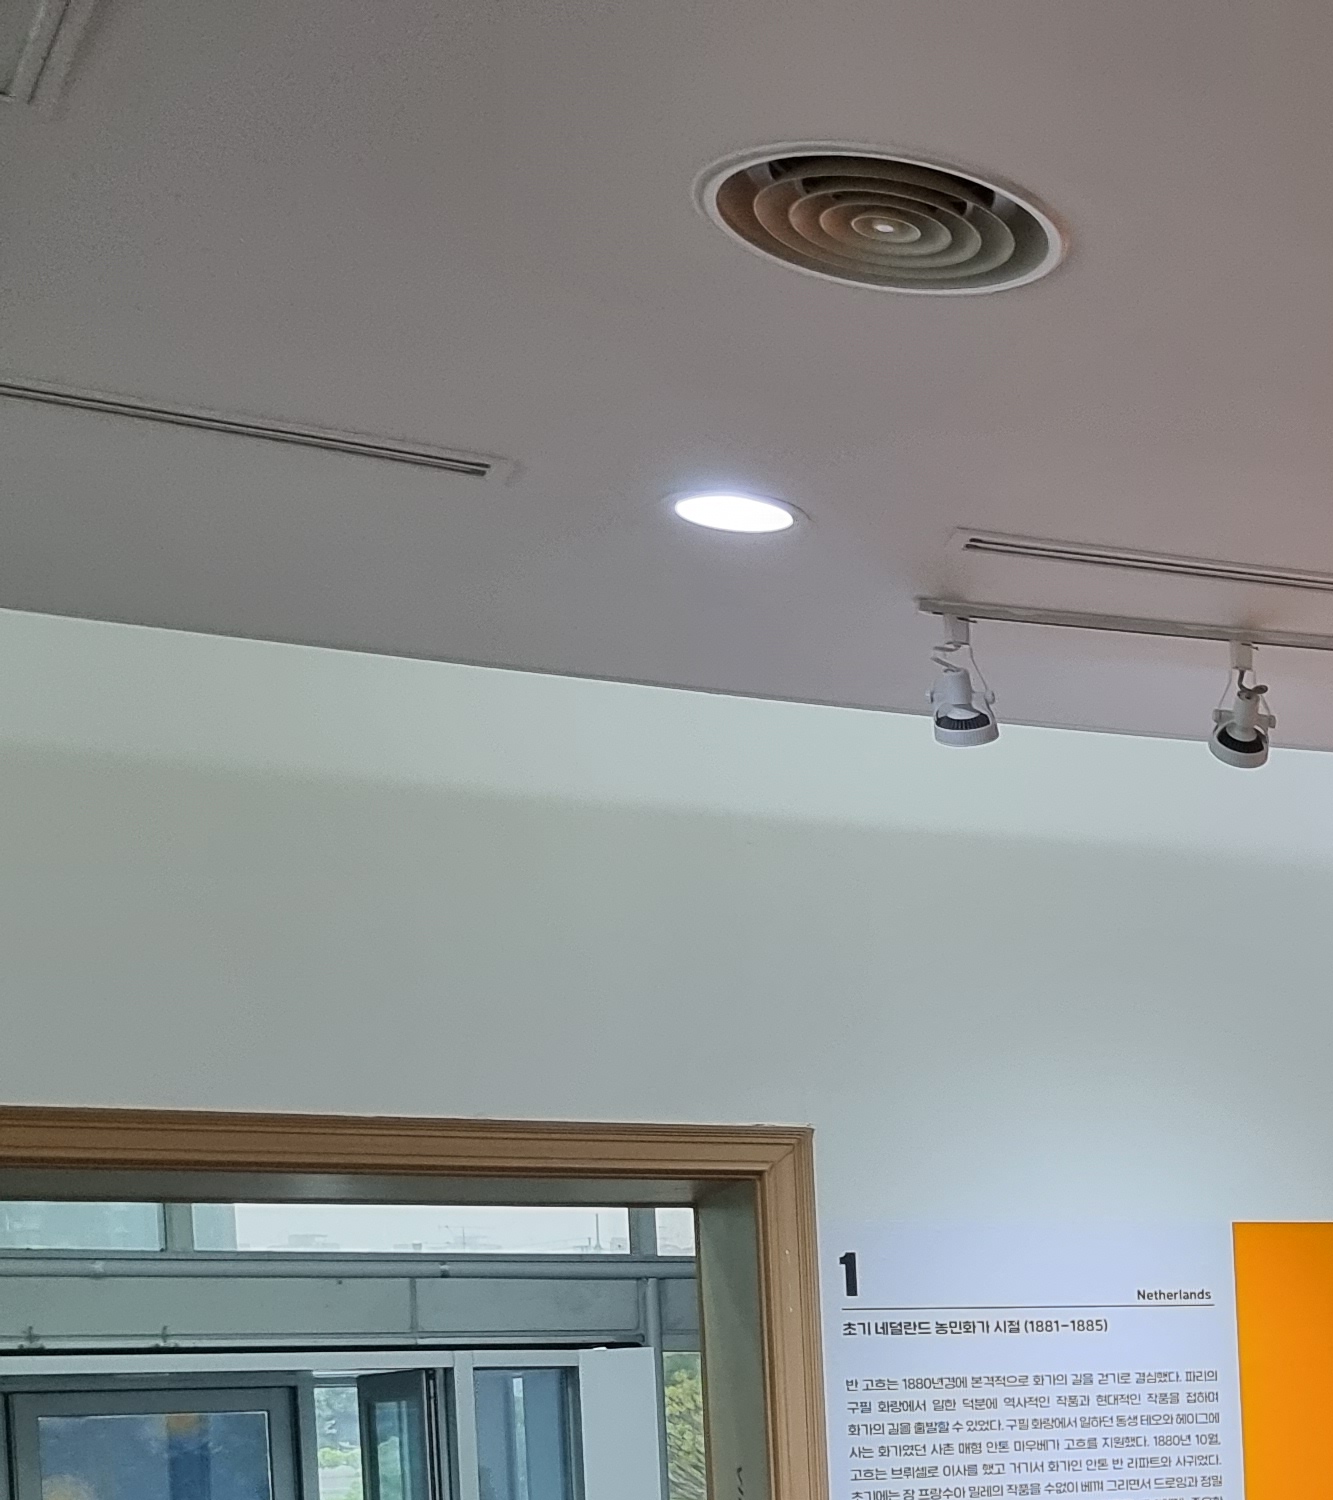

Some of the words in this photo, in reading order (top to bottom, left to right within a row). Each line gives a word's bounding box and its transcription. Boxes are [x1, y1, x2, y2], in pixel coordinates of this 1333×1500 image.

[839, 1252, 858, 1296] 1
[1137, 1289, 1211, 1300] Netherlands
[843, 1322, 871, 1336] 초기
[875, 1321, 931, 1335] 네덜란드
[935, 1321, 989, 1334] 농민화가
[994, 1320, 1020, 1333] 시절
[1024, 1319, 1107, 1333] (1881-1885)
